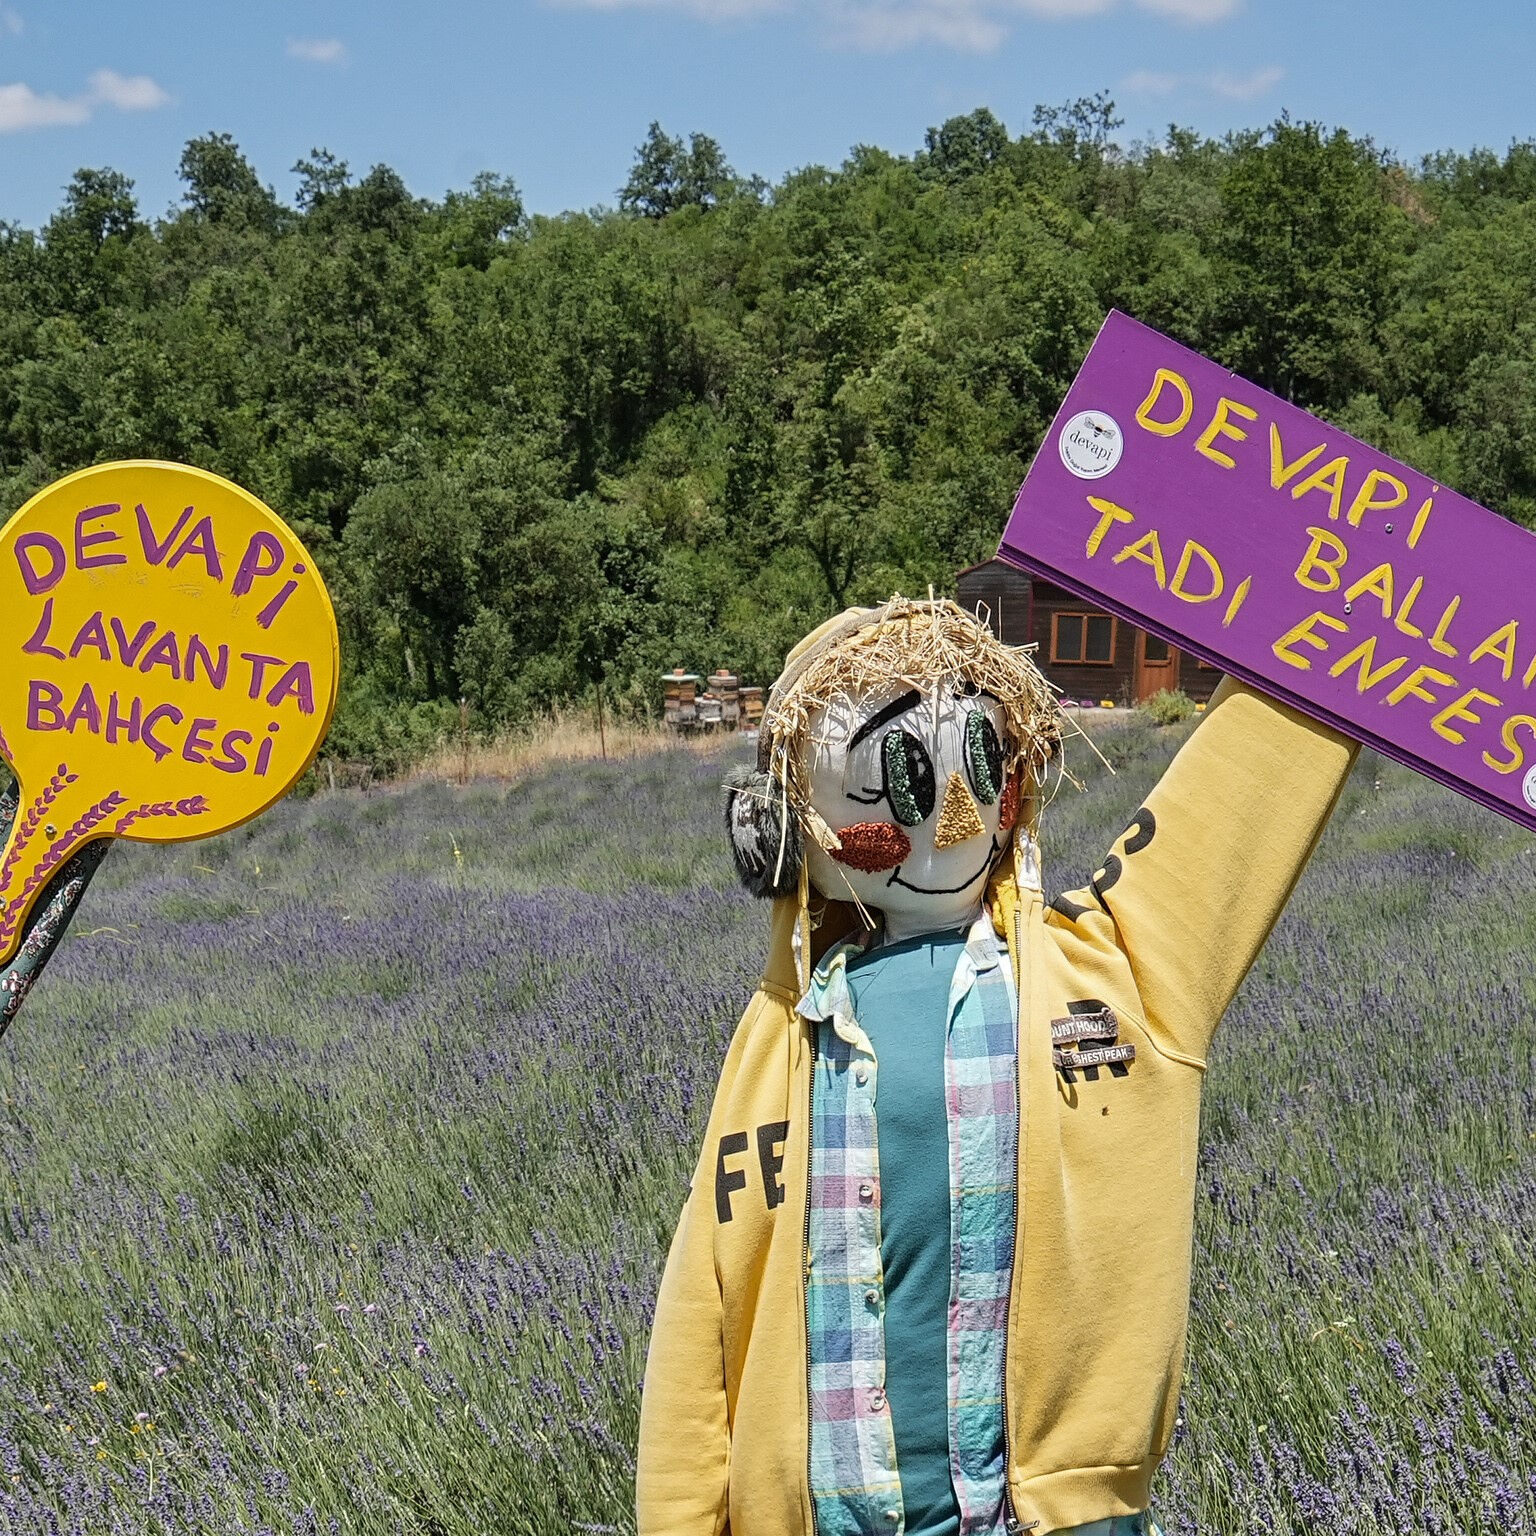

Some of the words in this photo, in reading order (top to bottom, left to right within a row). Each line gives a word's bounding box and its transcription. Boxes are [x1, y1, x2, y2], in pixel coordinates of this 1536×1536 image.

[1069, 430, 1113, 461] devapi
[1085, 495, 1252, 628] TADI
[22, 597, 316, 716] LAVANTA
[26, 680, 280, 777] BAHÇESİ
[1104, 1046, 1128, 1062] PEAK
